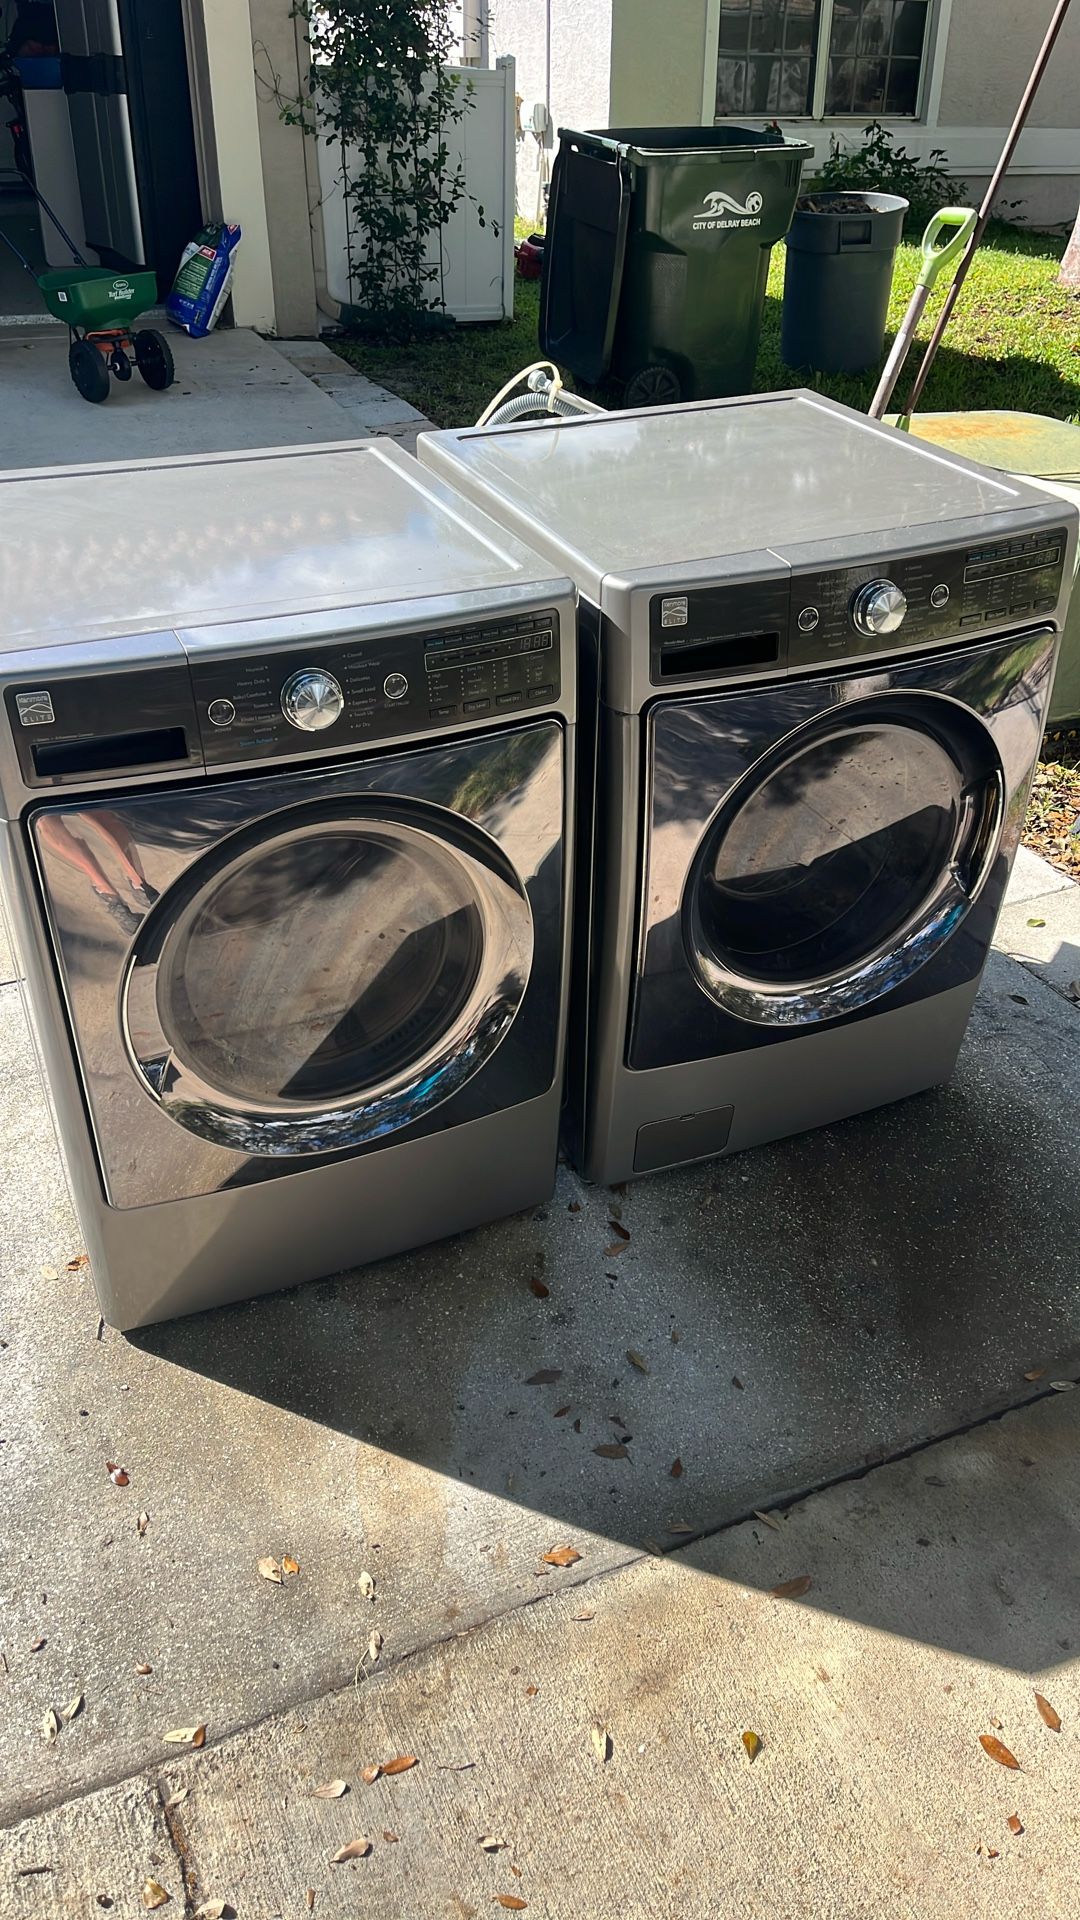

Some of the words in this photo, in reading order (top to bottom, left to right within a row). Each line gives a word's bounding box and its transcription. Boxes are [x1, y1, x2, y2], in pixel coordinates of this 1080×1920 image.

[693, 221, 707, 230] CITY
[707, 221, 716, 229] OF
[716, 220, 740, 228] DELRAY
[740, 218, 761, 227] BEACH
[663, 600, 686, 608] Kenmore
[663, 617, 686, 625] ELITE
[23, 714, 53, 723] ELITE
